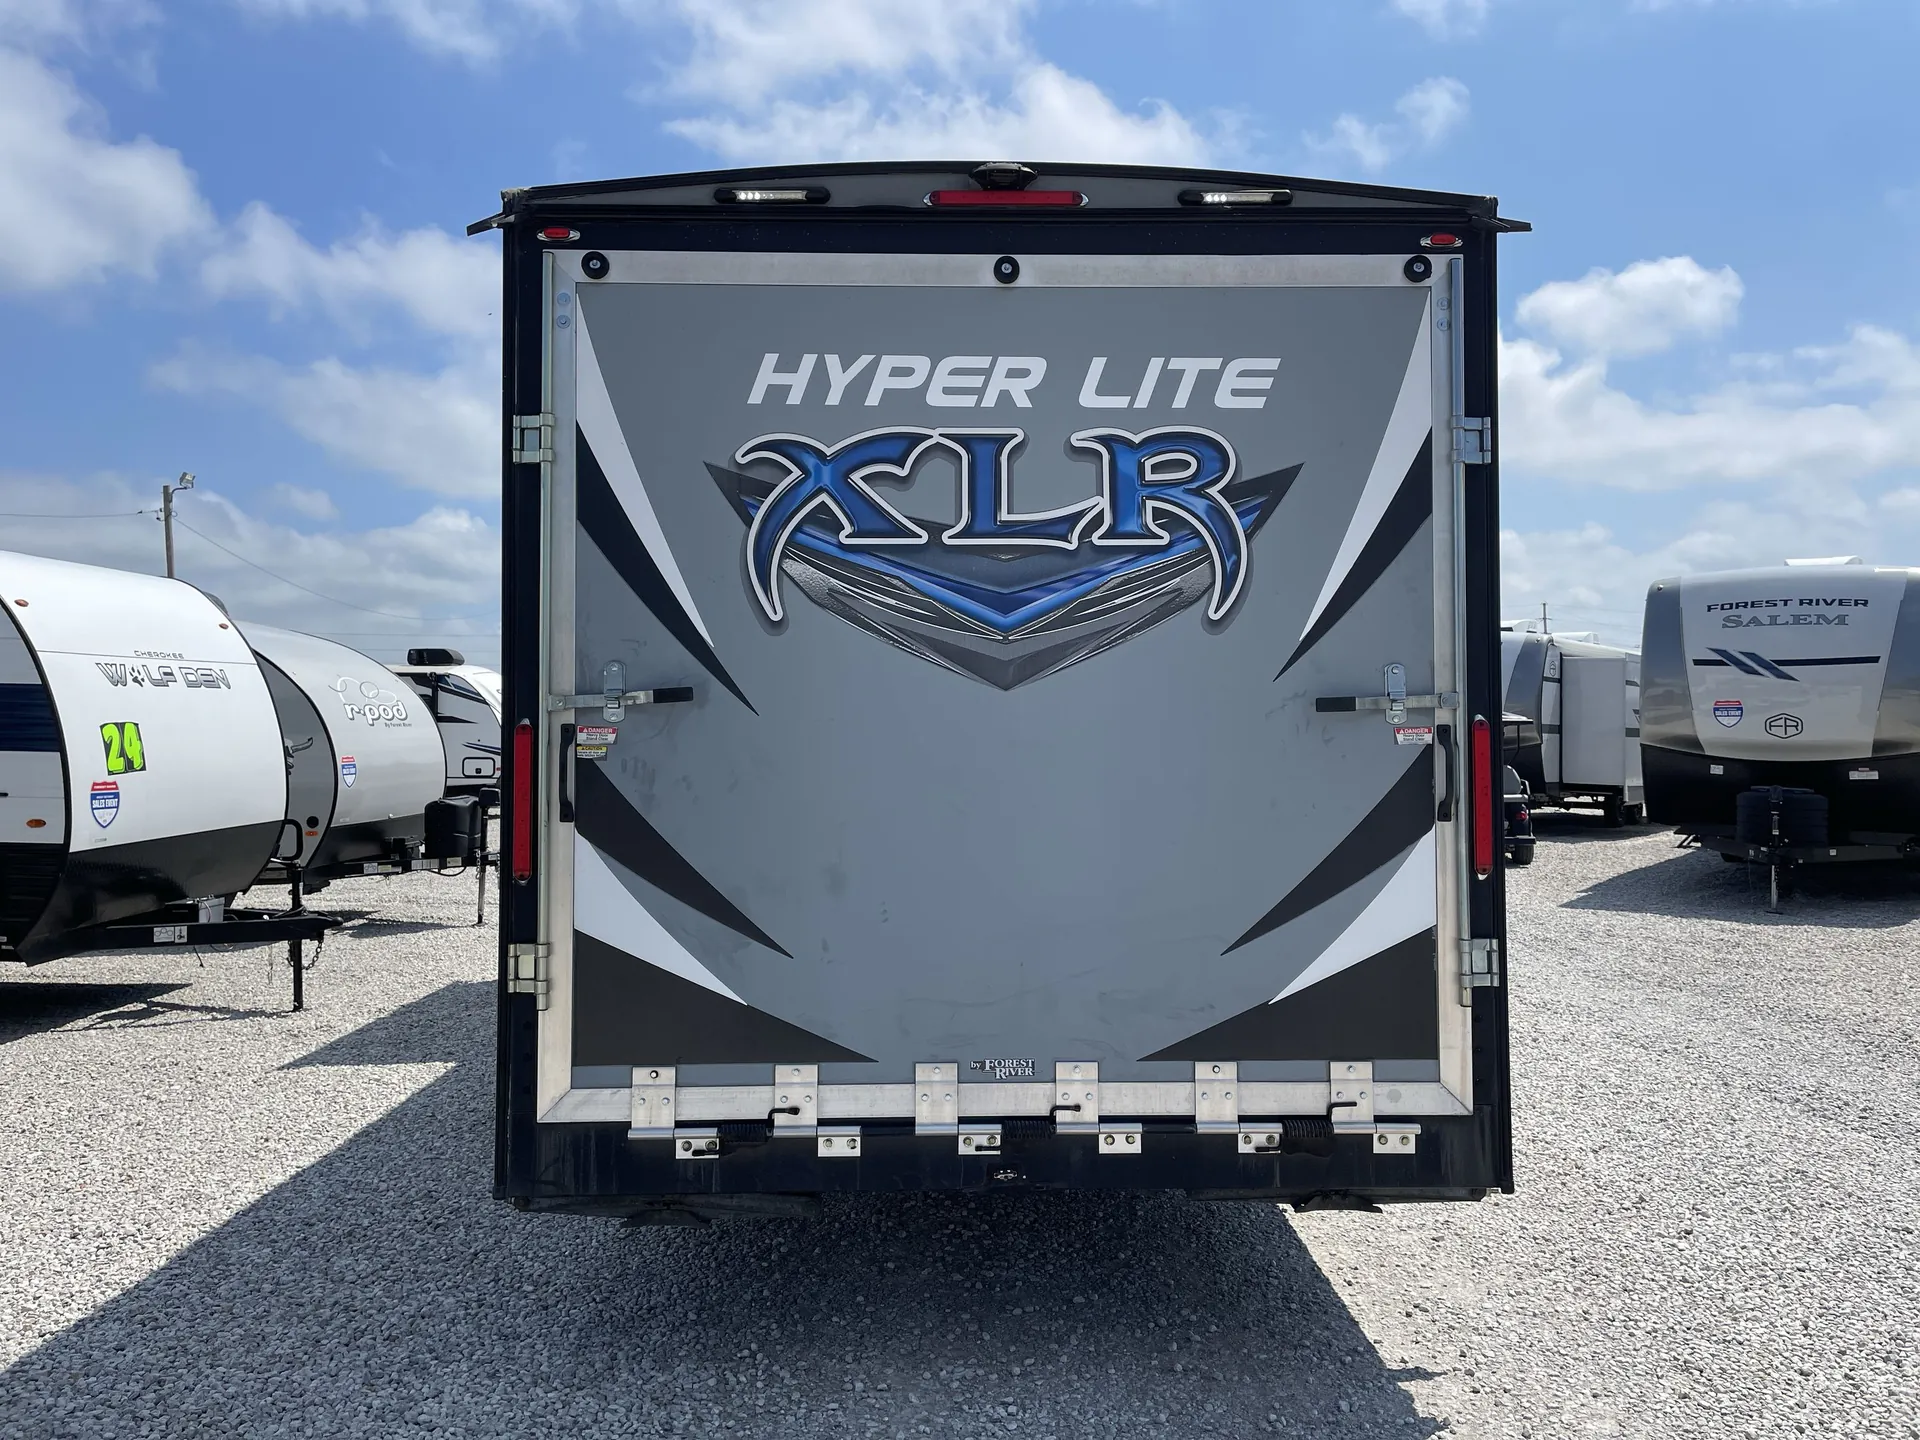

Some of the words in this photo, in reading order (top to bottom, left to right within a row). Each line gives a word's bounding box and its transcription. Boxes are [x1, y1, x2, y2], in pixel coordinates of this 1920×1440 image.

[747, 353, 1047, 408] HYPER
[1078, 356, 1281, 409] LITE
[735, 425, 1249, 622] XLR
[1706, 599, 1793, 612] FOREST
[1798, 598, 1869, 607] RIVER
[1721, 614, 1849, 628] SALEM
[133, 650, 184, 659] CHEROKEE
[178, 666, 231, 689] DEN
[102, 722, 144, 773] 24
[970, 1061, 982, 1070] by
[984, 1059, 1034, 1071] FOREST
[995, 1067, 1034, 1079] RIVER
